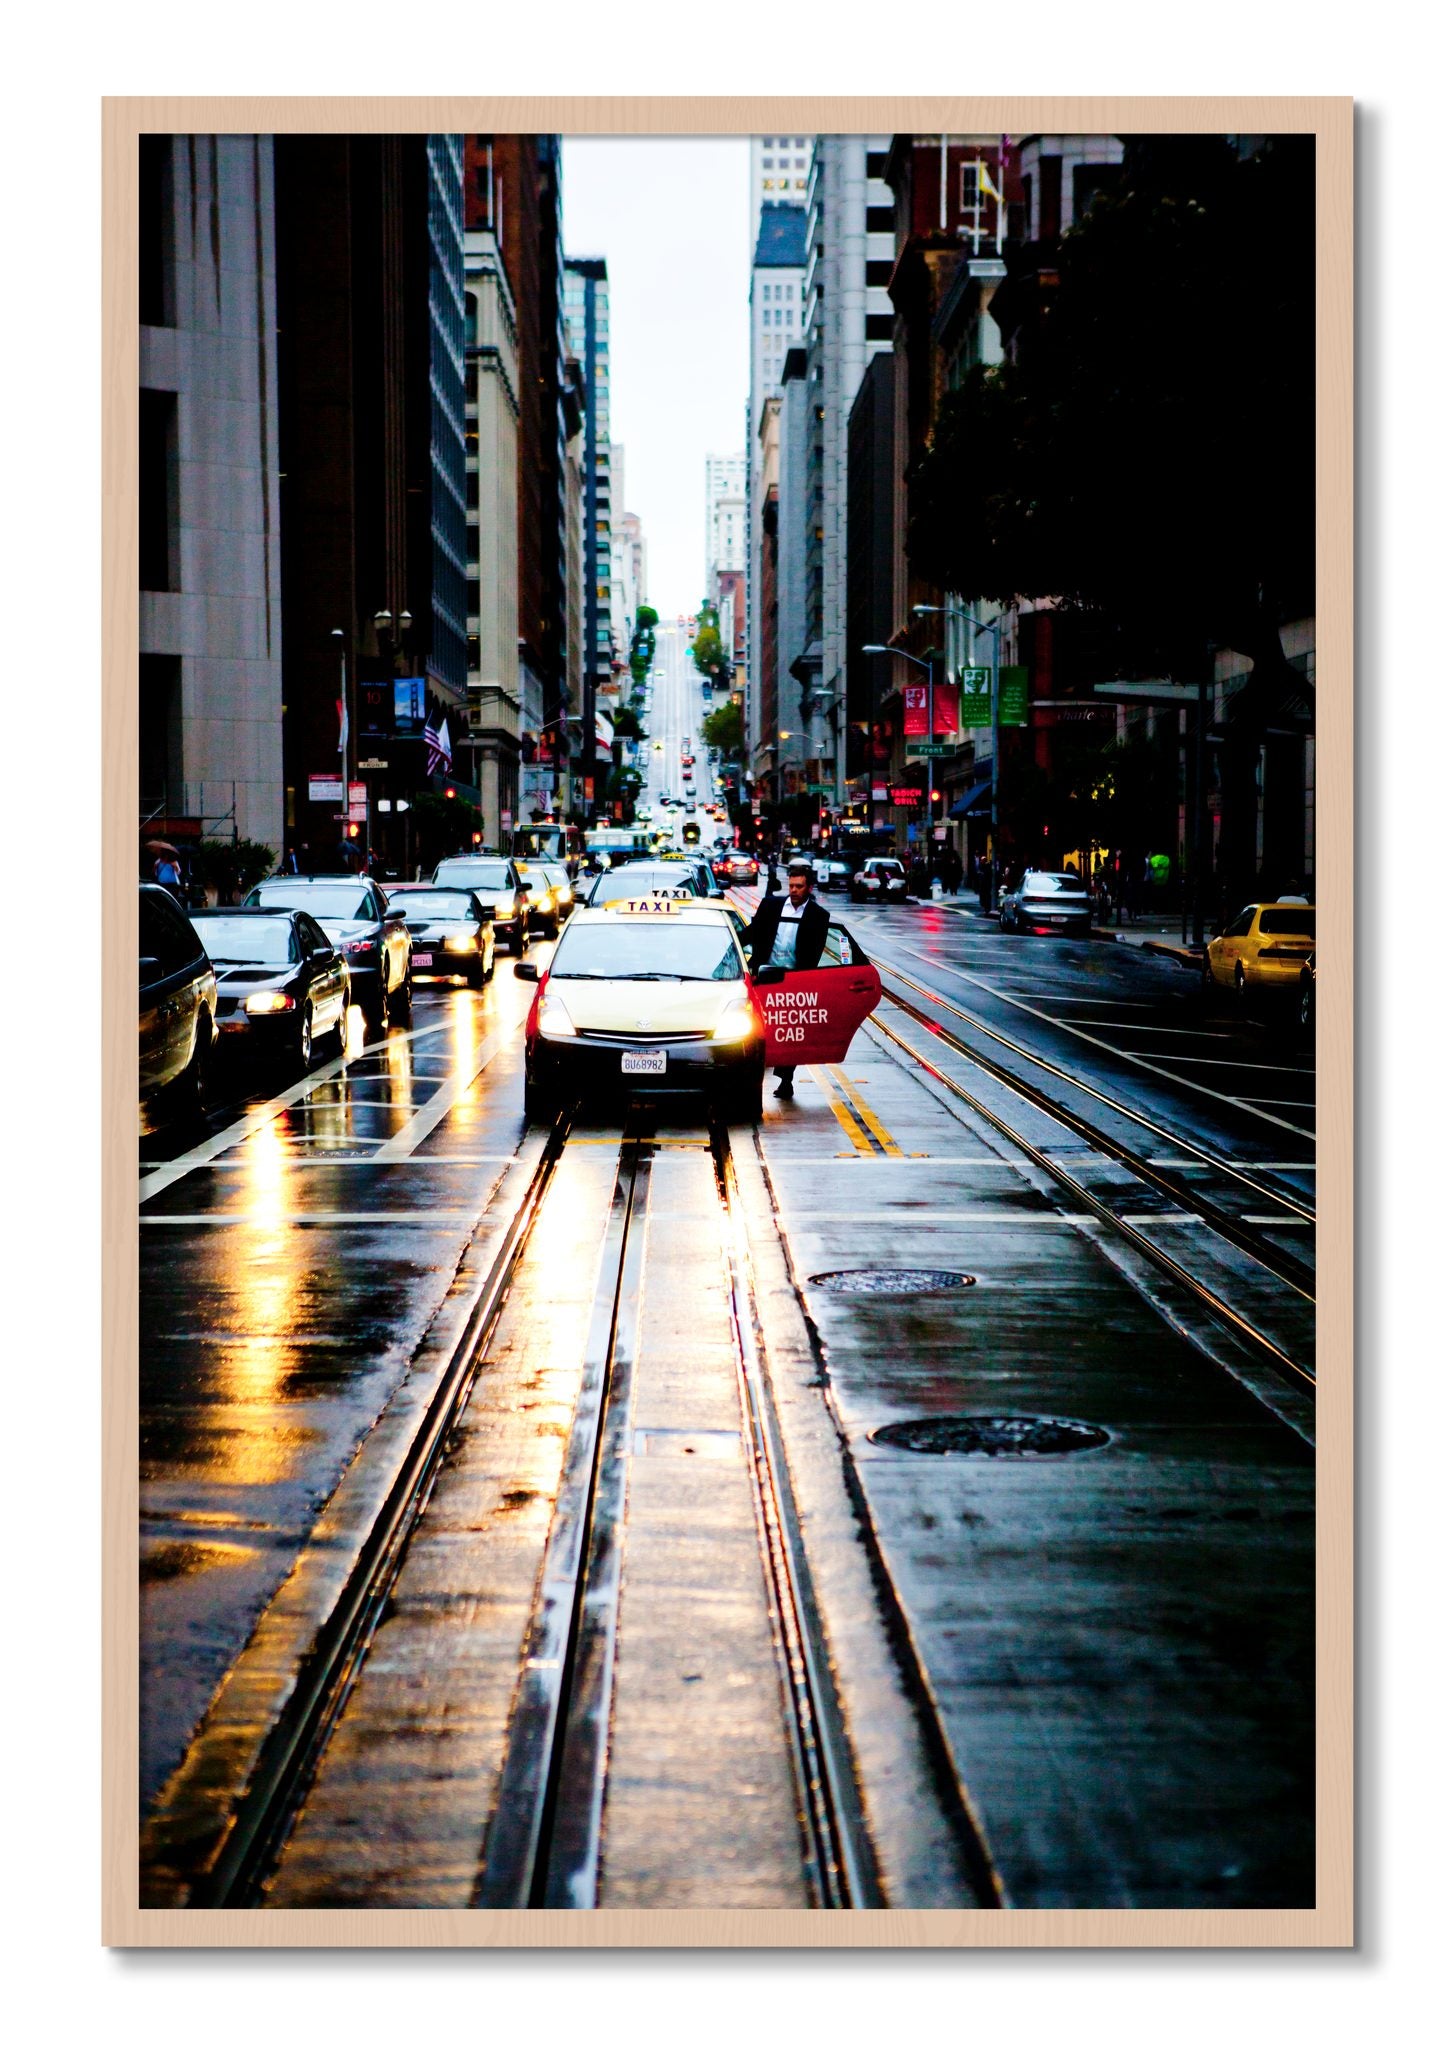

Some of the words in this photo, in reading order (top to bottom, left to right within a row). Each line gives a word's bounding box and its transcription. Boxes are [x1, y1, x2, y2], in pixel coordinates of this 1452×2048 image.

[919, 746, 943, 754] Front
[890, 789, 922, 798] TADICH
[894, 797, 918, 806] GRILL
[652, 890, 687, 898] TAXI
[628, 901, 671, 912] TAXI
[765, 991, 818, 1008] ARROW
[774, 1027, 805, 1043] CAB
[624, 1059, 663, 1070] 8U68982
